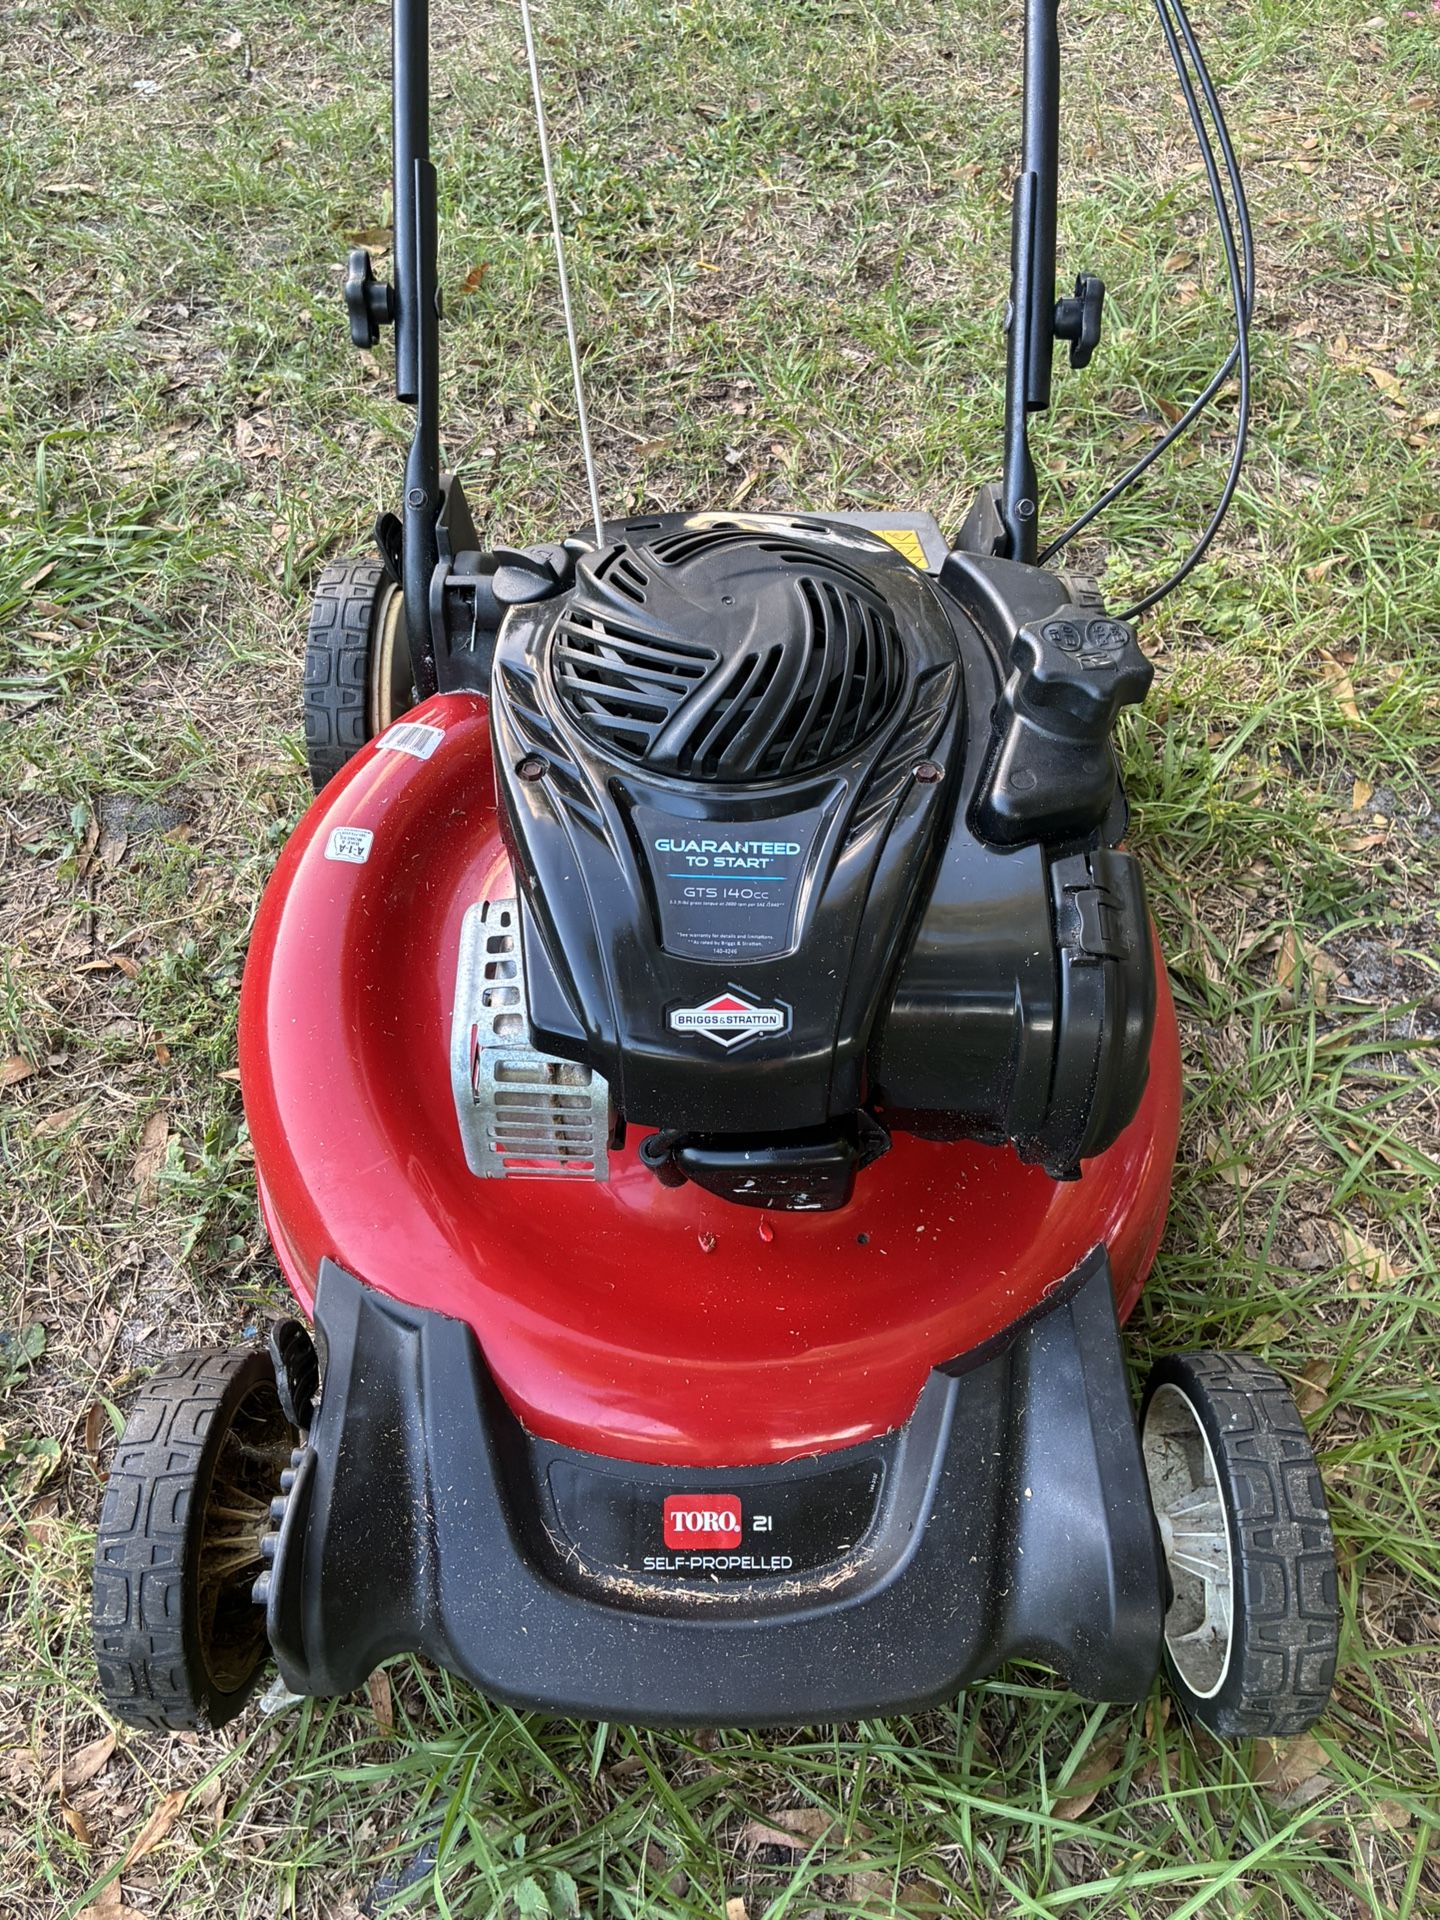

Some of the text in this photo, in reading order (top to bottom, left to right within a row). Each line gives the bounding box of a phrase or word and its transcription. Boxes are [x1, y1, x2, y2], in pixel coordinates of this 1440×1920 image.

[339, 844, 365, 855] A-1-A
[655, 838, 800, 855] GUARANTEED
[686, 856, 709, 867] TO
[683, 887, 769, 899] GTS 140cc
[670, 1511, 772, 1532] TORO 21
[643, 1555, 793, 1571] SELF-PROPELLED
